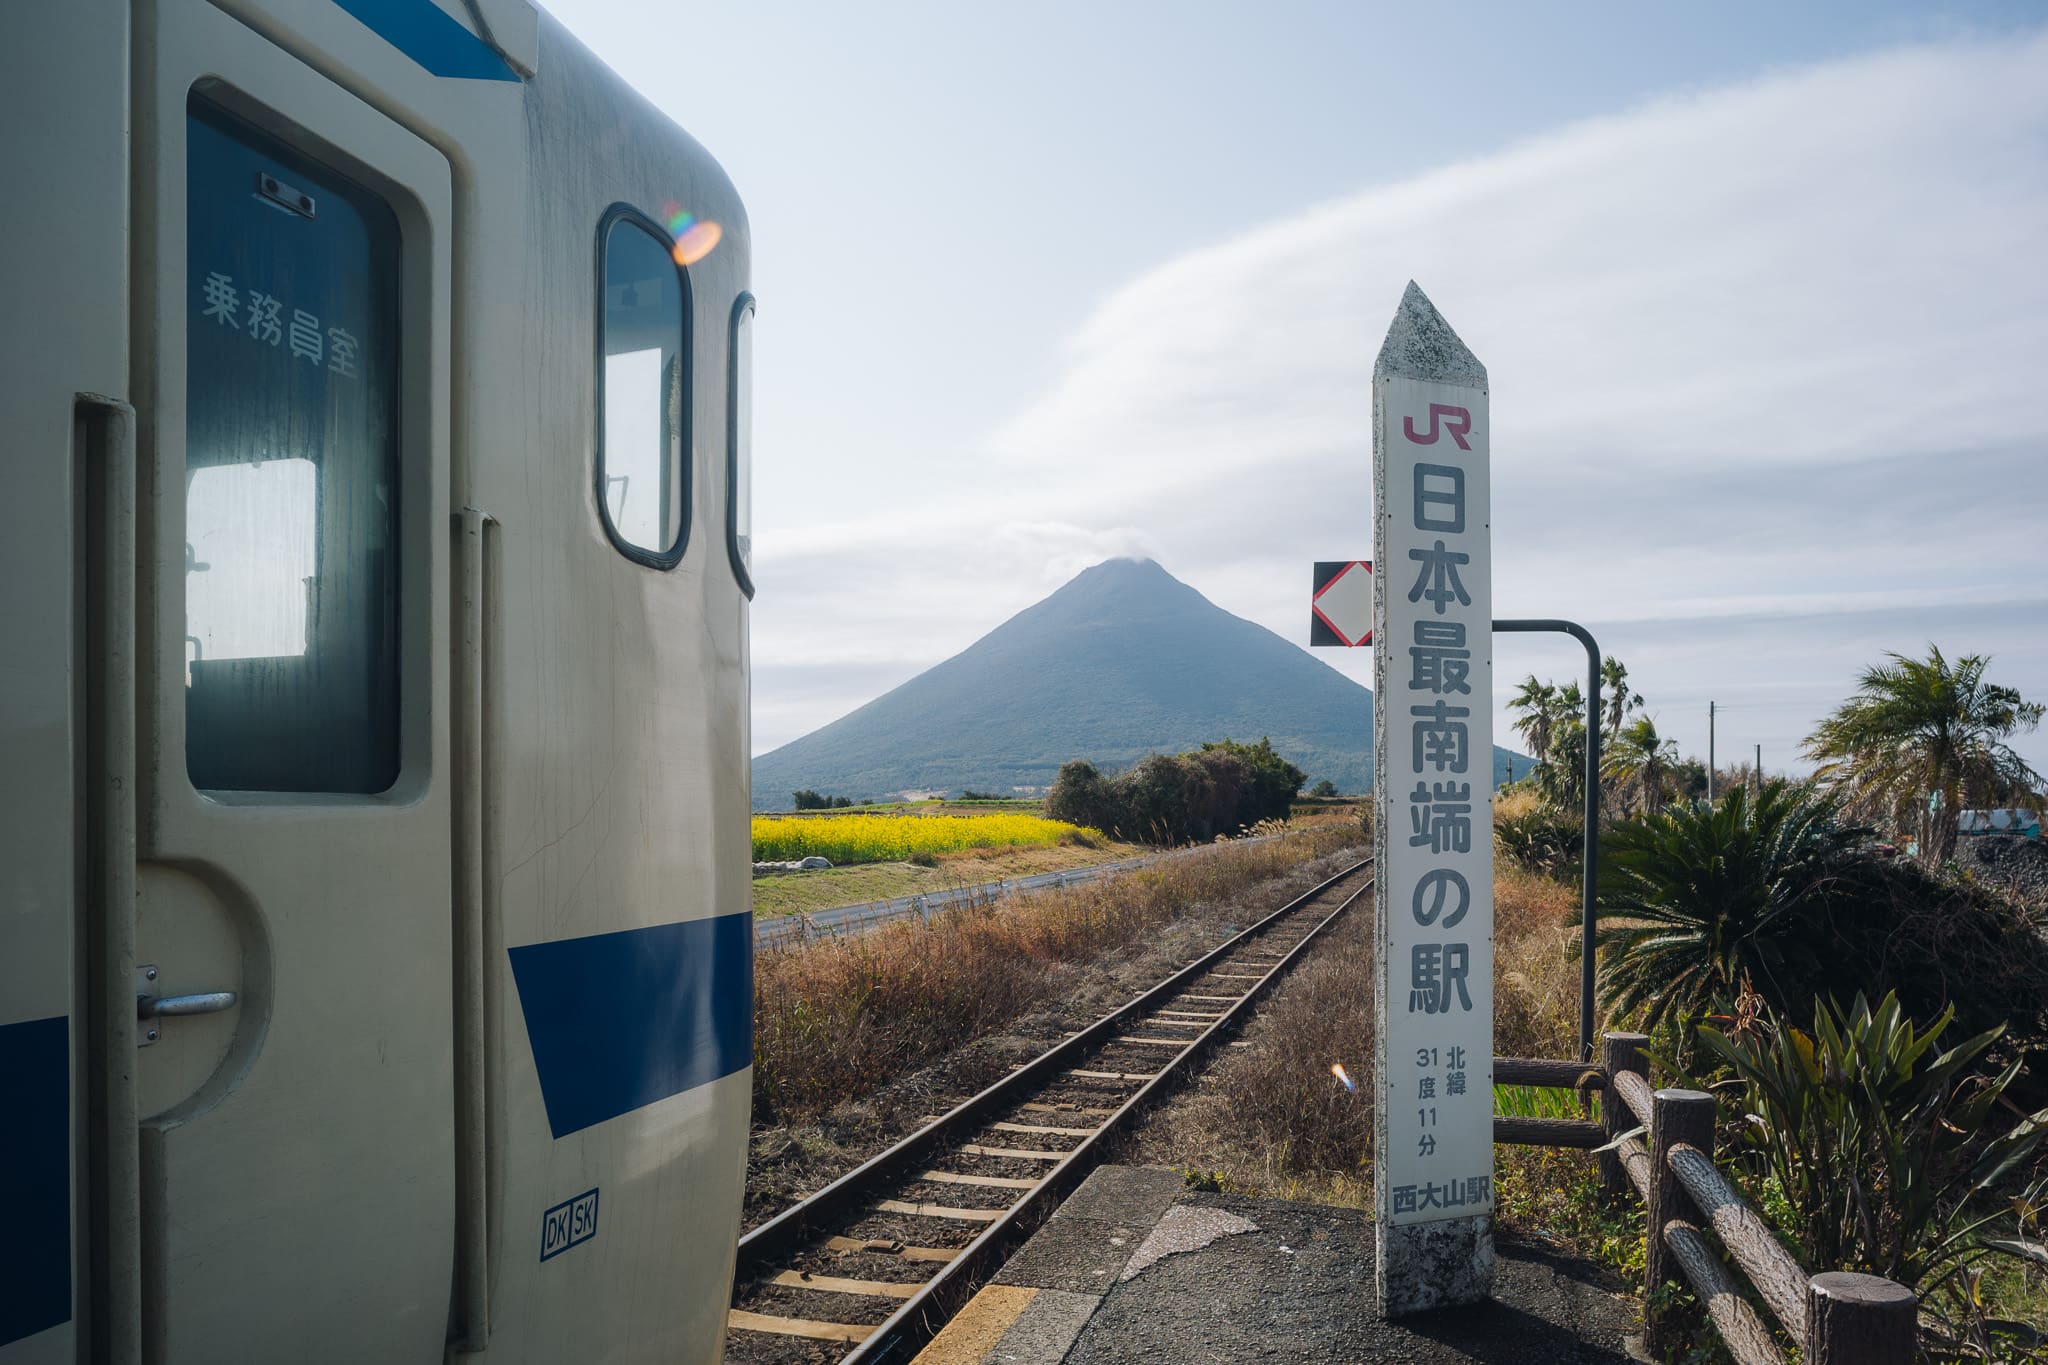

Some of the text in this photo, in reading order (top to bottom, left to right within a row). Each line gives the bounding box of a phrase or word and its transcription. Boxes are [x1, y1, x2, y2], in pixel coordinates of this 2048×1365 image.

[202, 271, 359, 378] 乗務員室
[1403, 403, 1472, 451] JR
[1408, 462, 1473, 1015] 日本最南端の駅
[1446, 1046, 1467, 1097] 北緯
[1392, 1175, 1490, 1216] 西大山駅
[546, 1199, 594, 1249] DK SK
